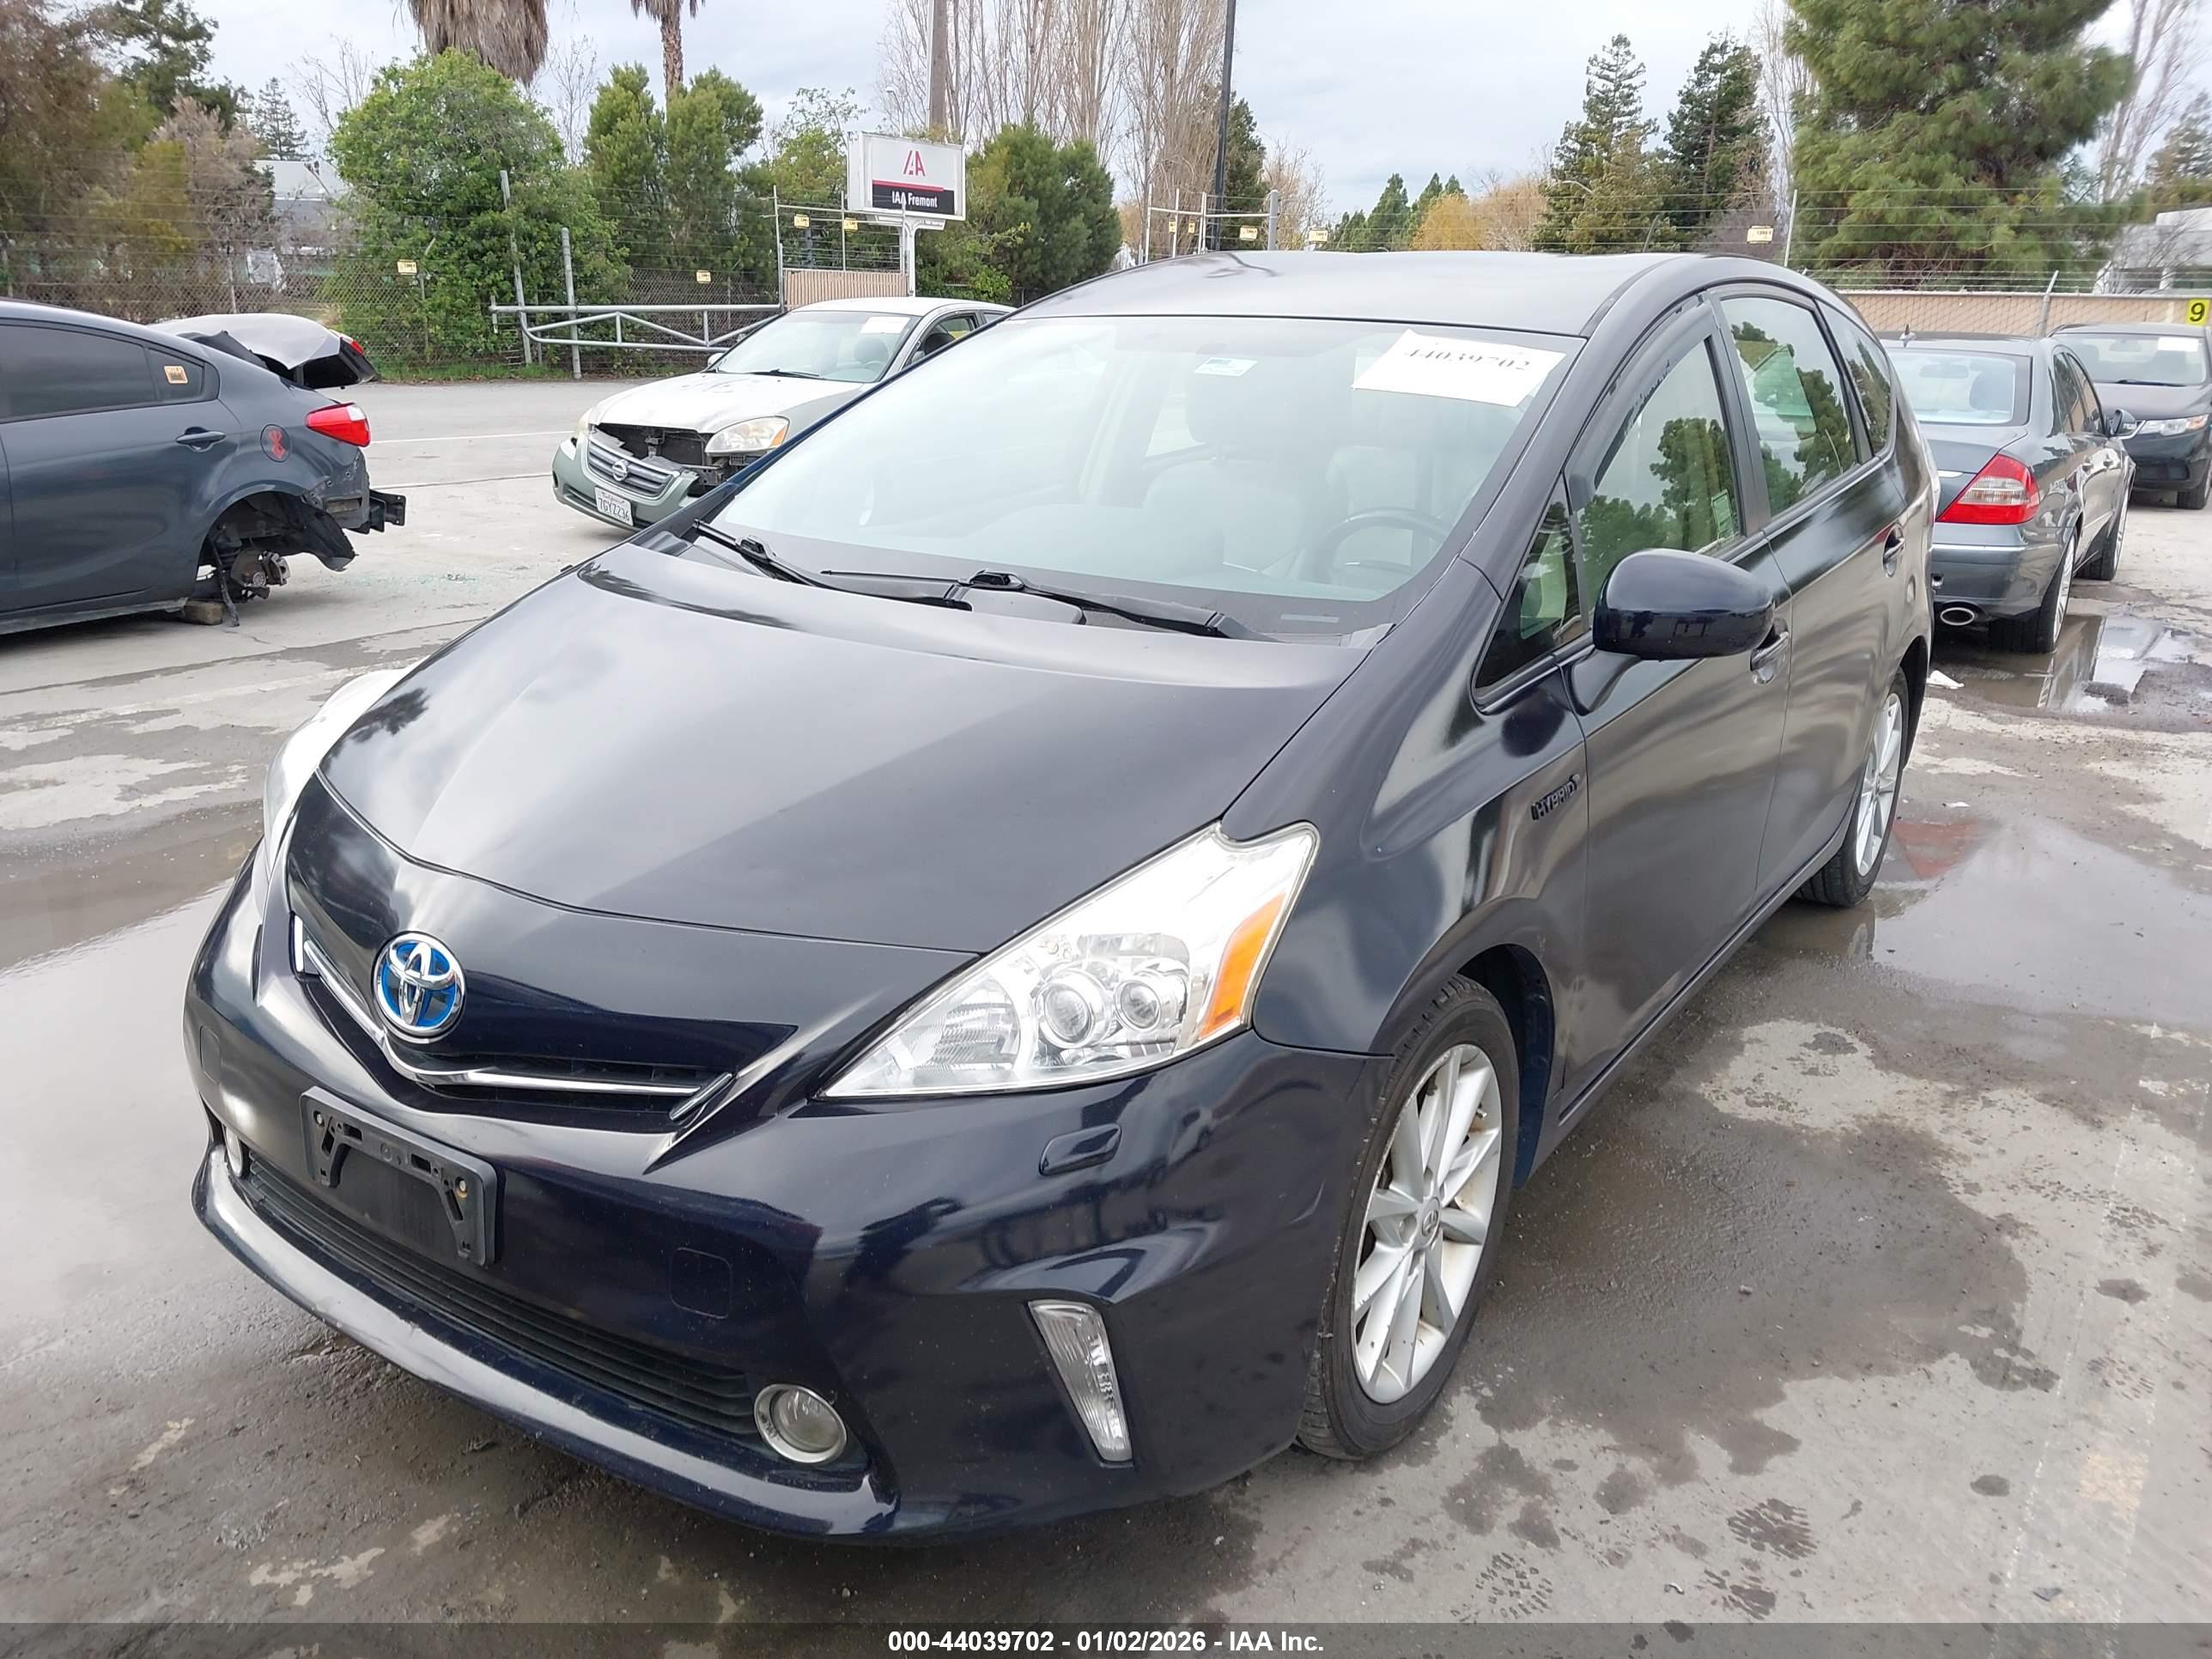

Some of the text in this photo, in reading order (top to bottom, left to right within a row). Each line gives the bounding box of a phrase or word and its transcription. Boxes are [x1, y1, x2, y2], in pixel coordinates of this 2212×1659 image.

[891, 191, 938, 208] IAA Fremont
[2189, 302, 2206, 322] 9
[1531, 775, 1578, 820] HYBRID
